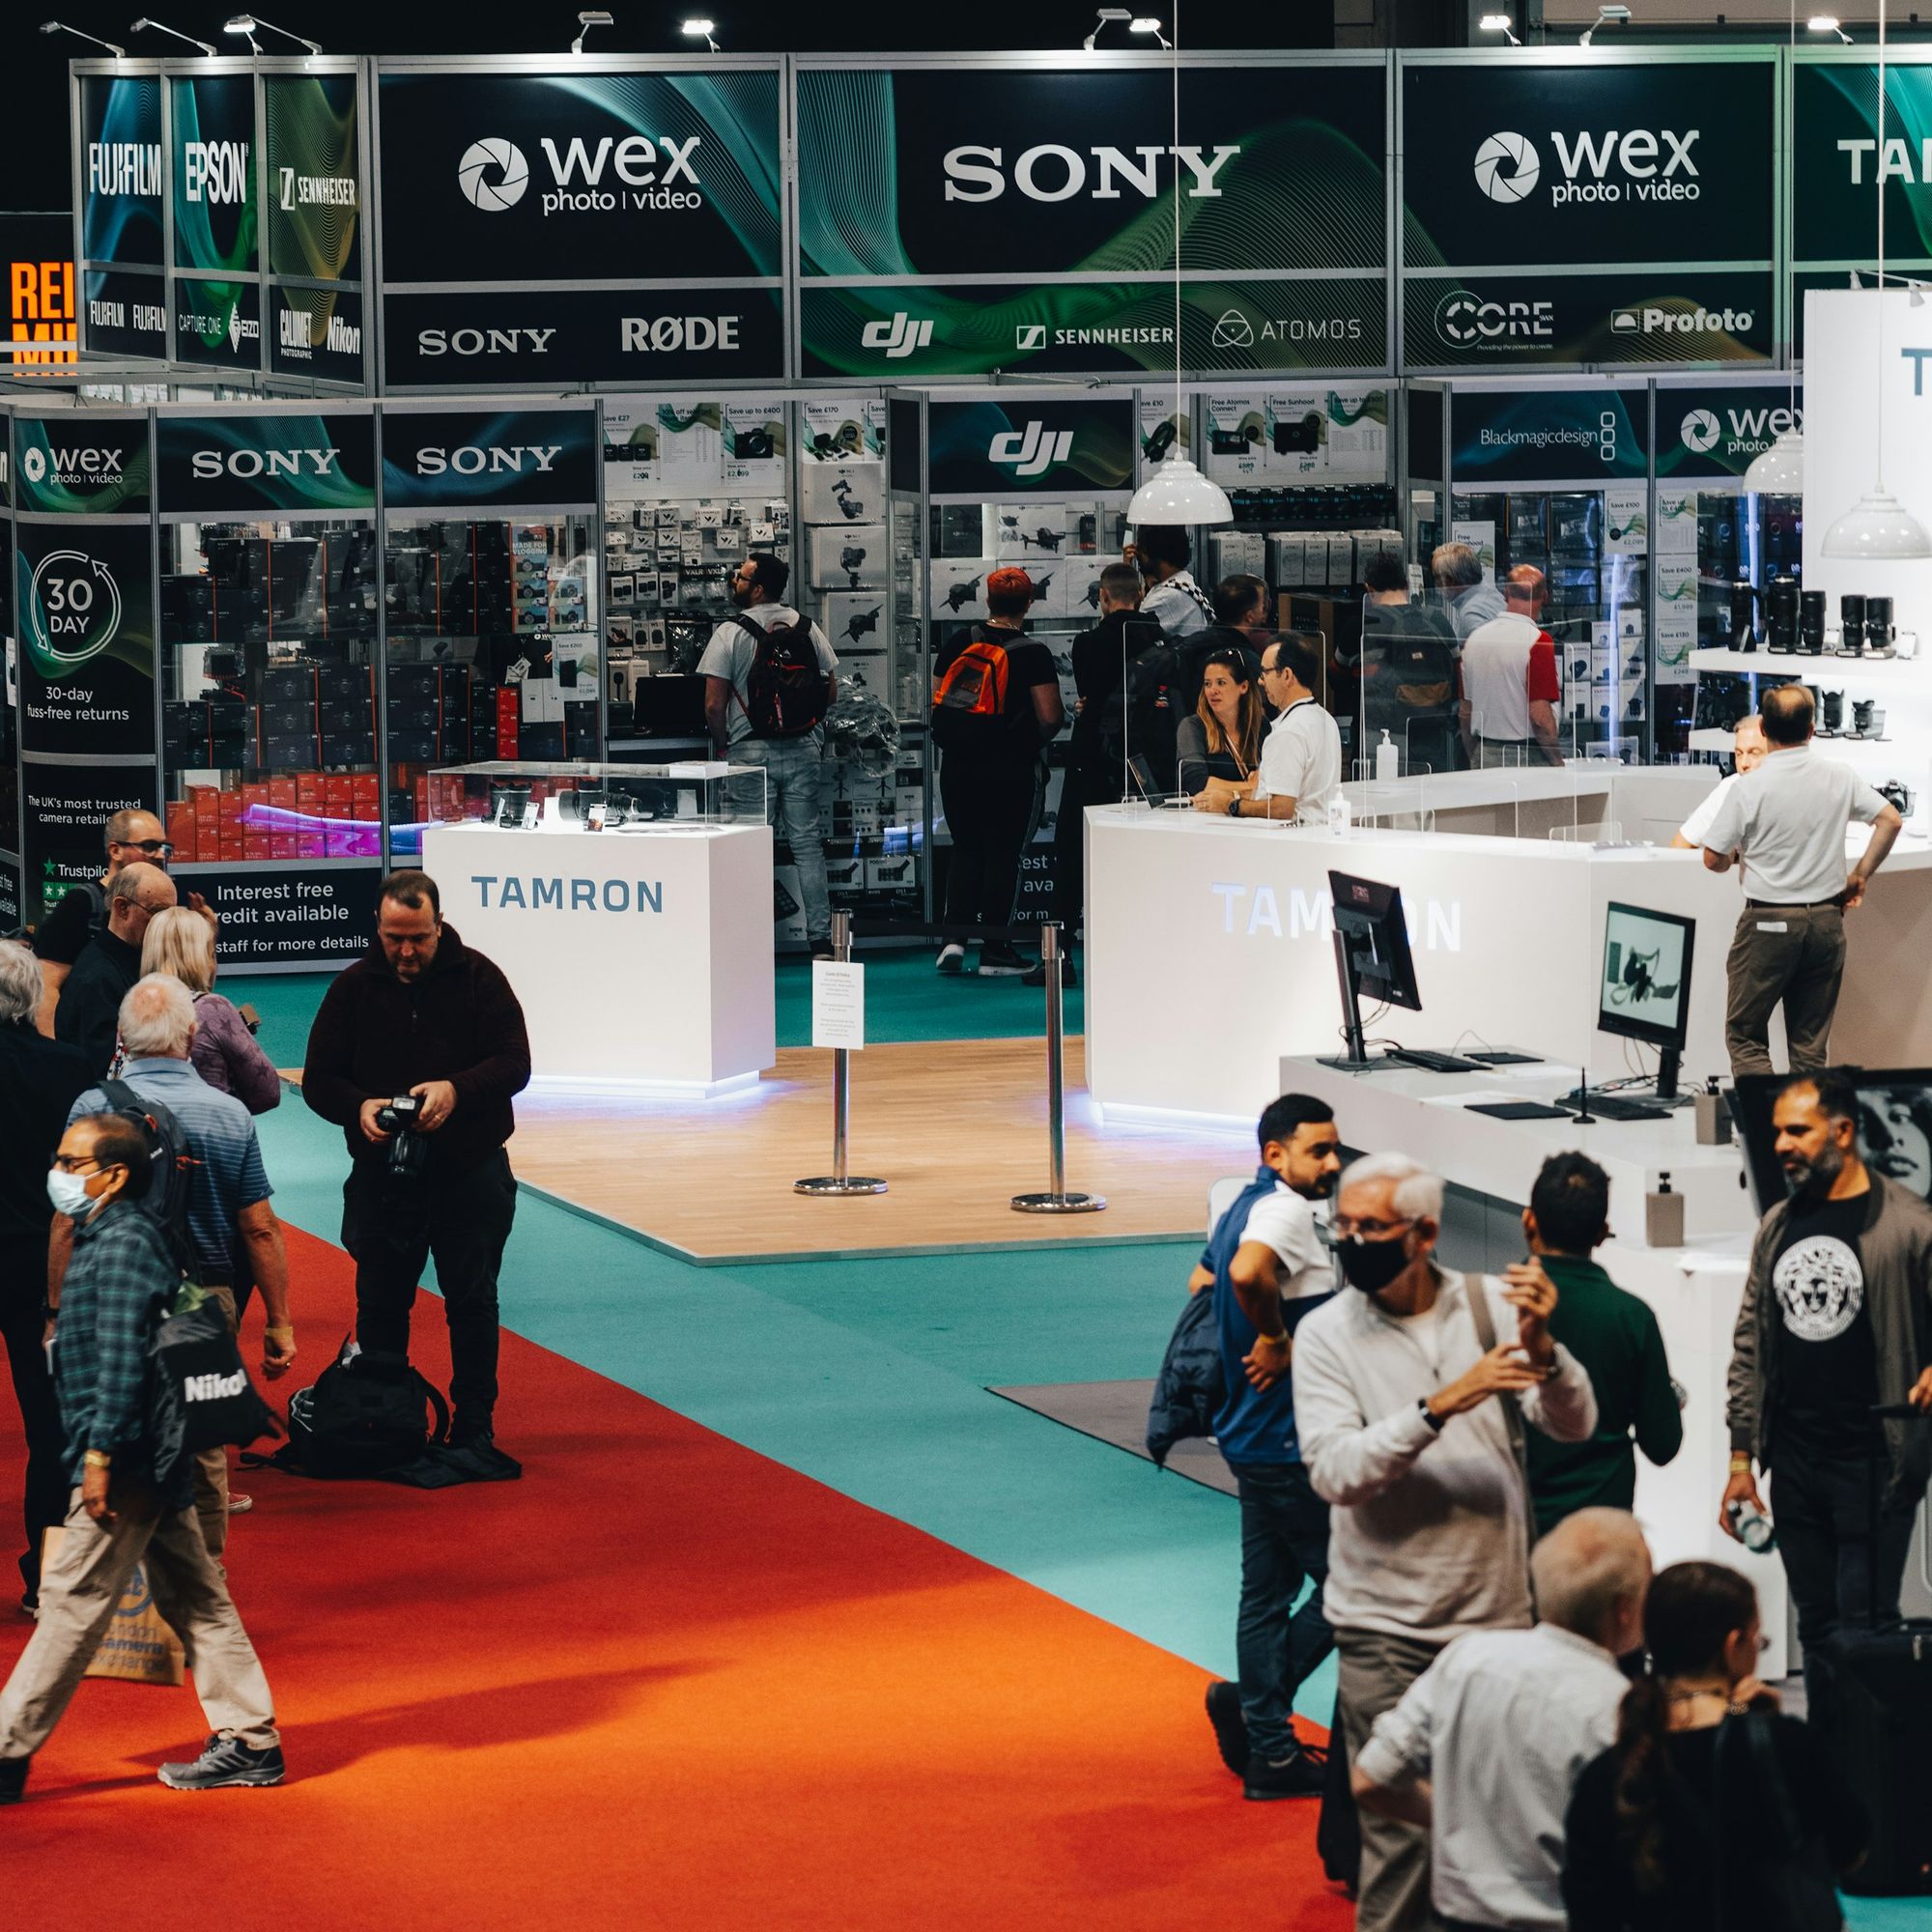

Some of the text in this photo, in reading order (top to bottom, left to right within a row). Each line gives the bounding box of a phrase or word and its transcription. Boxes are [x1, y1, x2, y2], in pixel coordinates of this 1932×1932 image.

[540, 135, 701, 186] wex
[1550, 129, 1700, 179] wex
[1837, 138, 1932, 185] TA
[89, 142, 162, 196] FUJIFILM
[185, 141, 246, 204] EPSON
[943, 144, 1240, 202] SONY
[298, 178, 356, 206] SENNHEISER
[542, 187, 702, 216] photo video
[1551, 181, 1700, 208] photo video
[90, 300, 124, 327] FUJIFILM
[178, 314, 222, 335] CAPTURE ONE
[1446, 300, 1553, 340] CORE
[1643, 307, 1753, 334] Profoto
[241, 320, 259, 338] EIZO
[280, 309, 361, 355] CALUMET Nikon
[418, 328, 556, 355] SONY
[621, 316, 740, 352] RØDE
[1055, 327, 1175, 345] SENNHEISER
[1261, 318, 1362, 341] ATOMOS
[281, 348, 312, 359] PHOTOGRAPHIC
[1480, 428, 1598, 449] Blackmagicdesign
[1727, 440, 1769, 456] photo
[49, 447, 122, 473] wex
[192, 449, 341, 478] SONY
[416, 445, 563, 474] SONY
[50, 471, 123, 486] photo video
[46, 577, 94, 611] 30
[50, 616, 90, 634] DAY
[45, 686, 94, 703] 30-day
[27, 704, 129, 721] fuss-free returns
[28, 795, 141, 810] The UK's most trusted
[39, 812, 113, 825] camera retaile
[58, 864, 110, 880] Trustpilo
[217, 882, 334, 901] Interest free
[470, 875, 663, 914] TAMRON
[214, 904, 350, 924] redit available
[1210, 881, 1461, 952] TAMON
[215, 935, 369, 953] staff for more details
[185, 1368, 247, 1403] Niko
